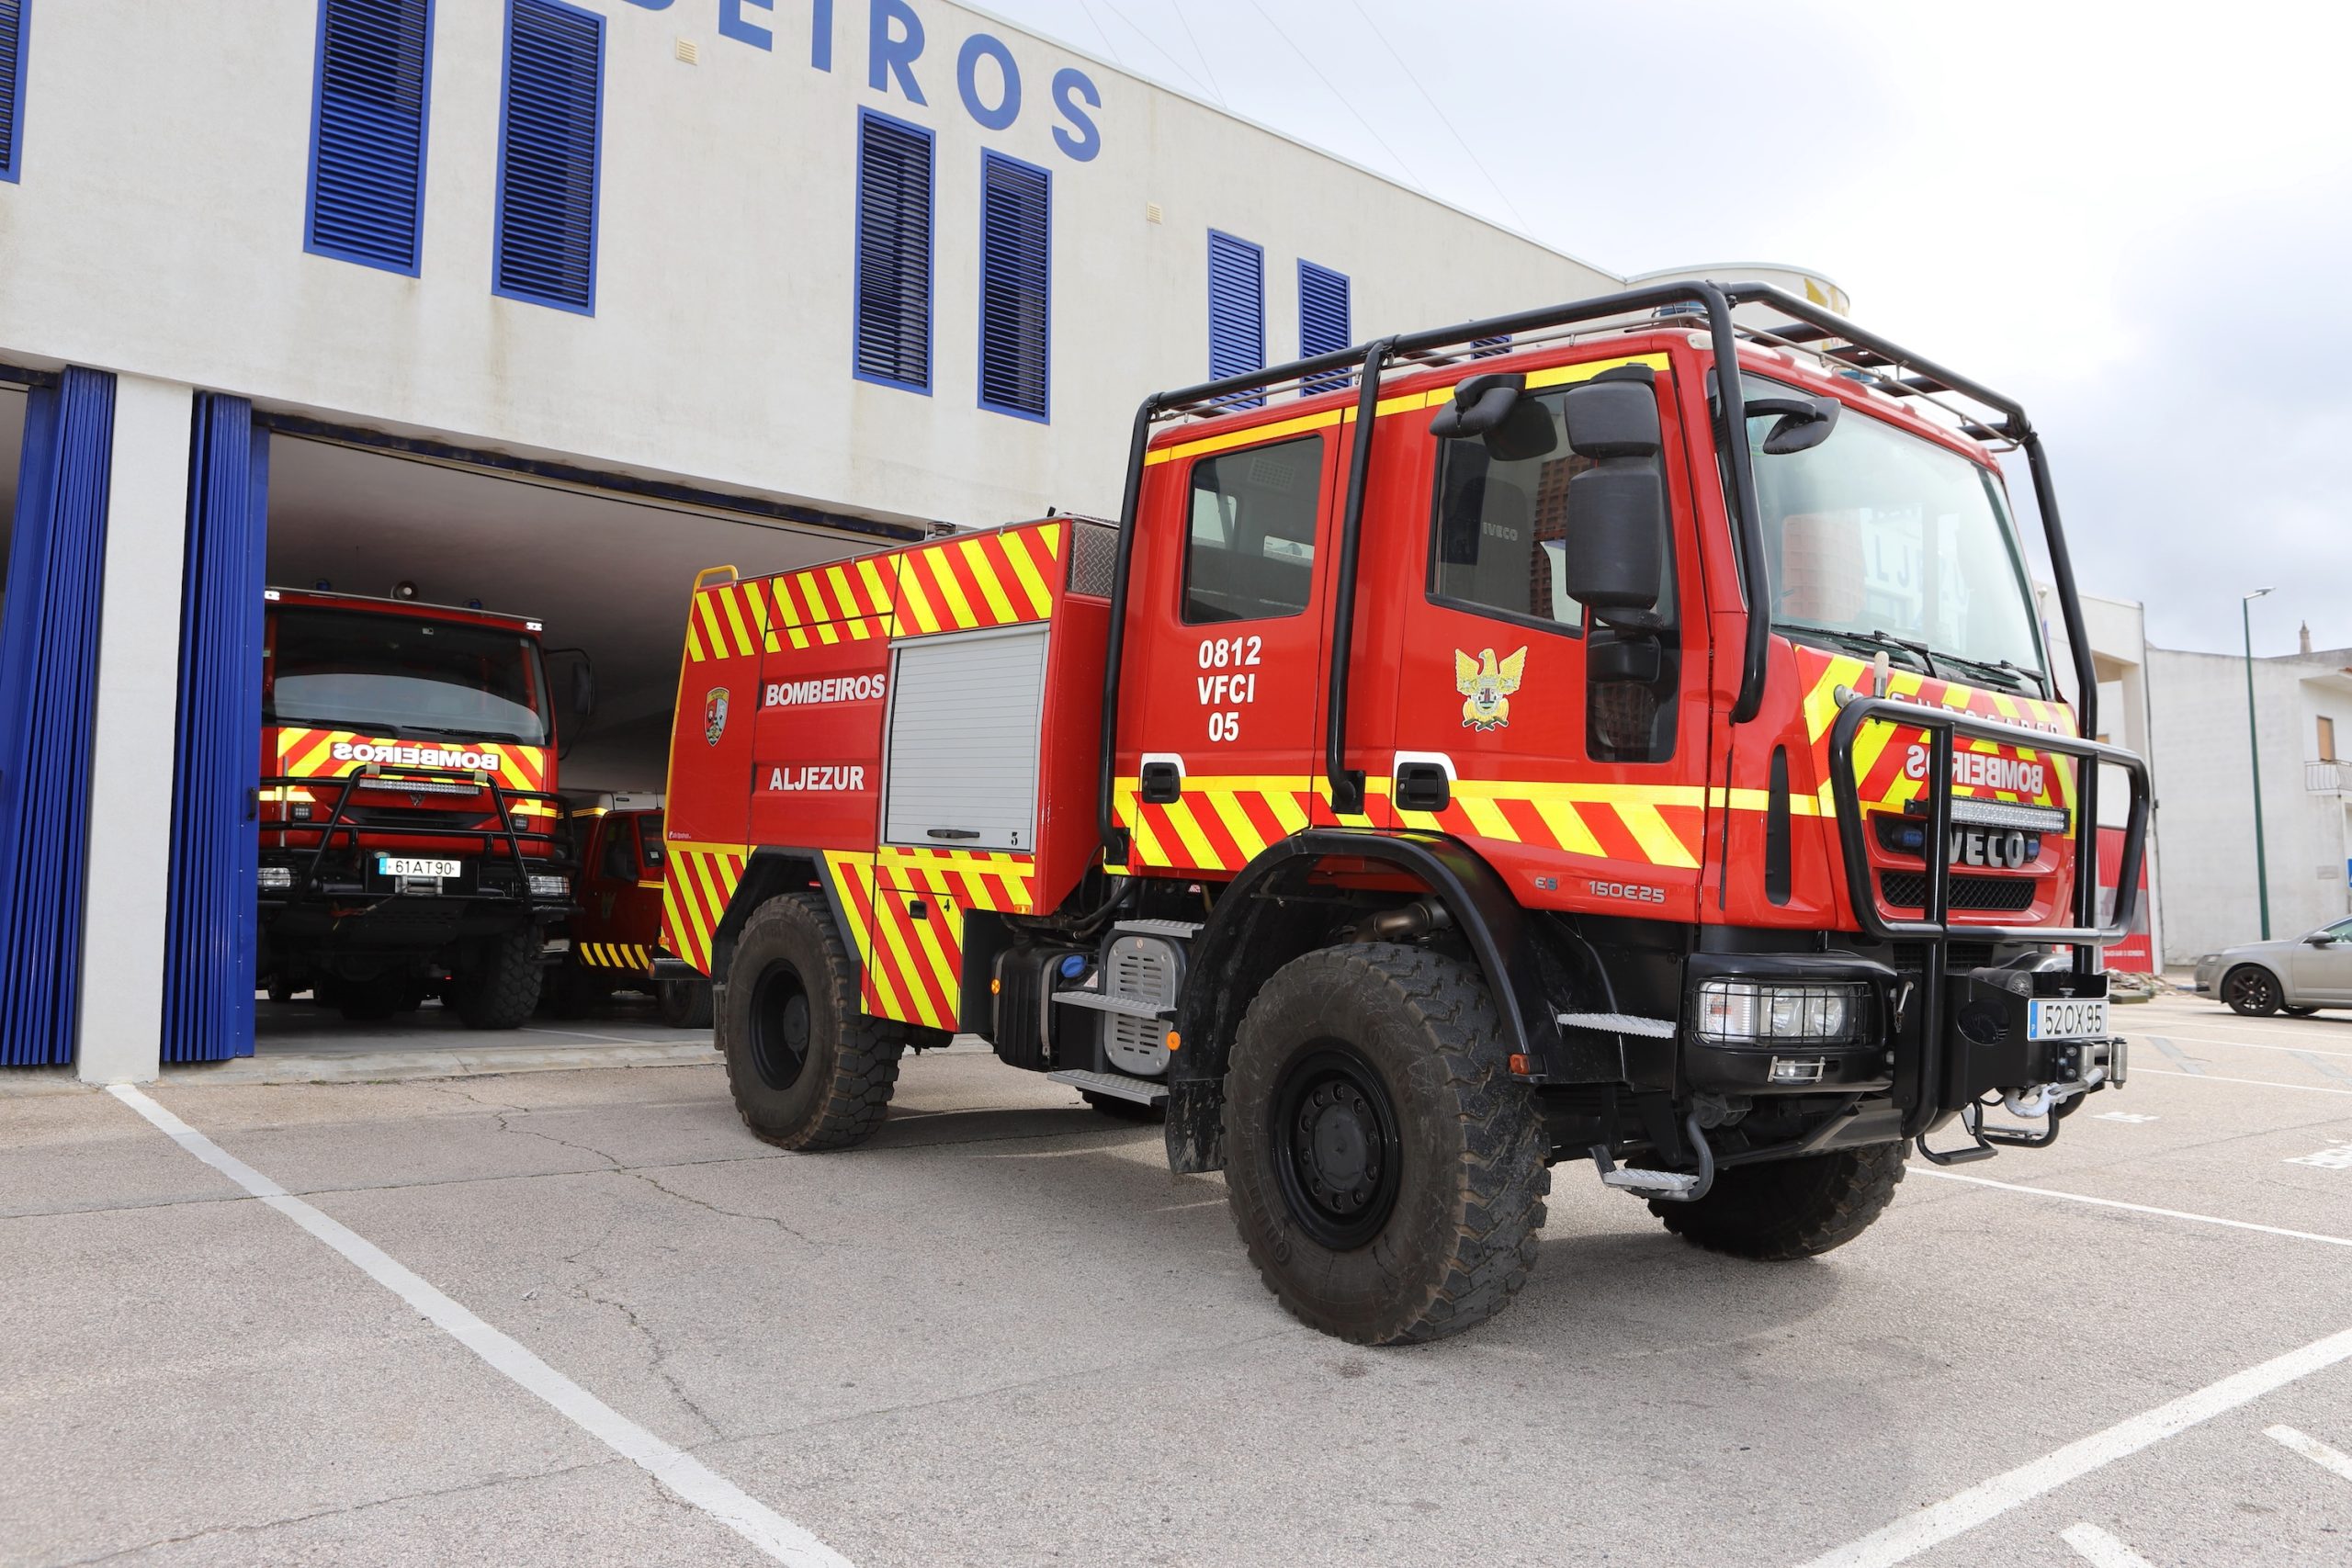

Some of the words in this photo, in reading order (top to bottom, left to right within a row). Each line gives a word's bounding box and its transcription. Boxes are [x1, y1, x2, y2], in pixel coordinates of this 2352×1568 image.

[1482, 522, 1519, 542] IVECO
[1198, 635, 1262, 670] 0812
[764, 673, 886, 706] BOMBEIROS
[1197, 672, 1256, 705] VFCI
[1208, 711, 1239, 742] 05
[769, 765, 865, 791] ALJEZUR
[395, 860, 452, 875] 61AT90
[1589, 880, 1666, 903] 150E25
[944, 898, 951, 912] 4
